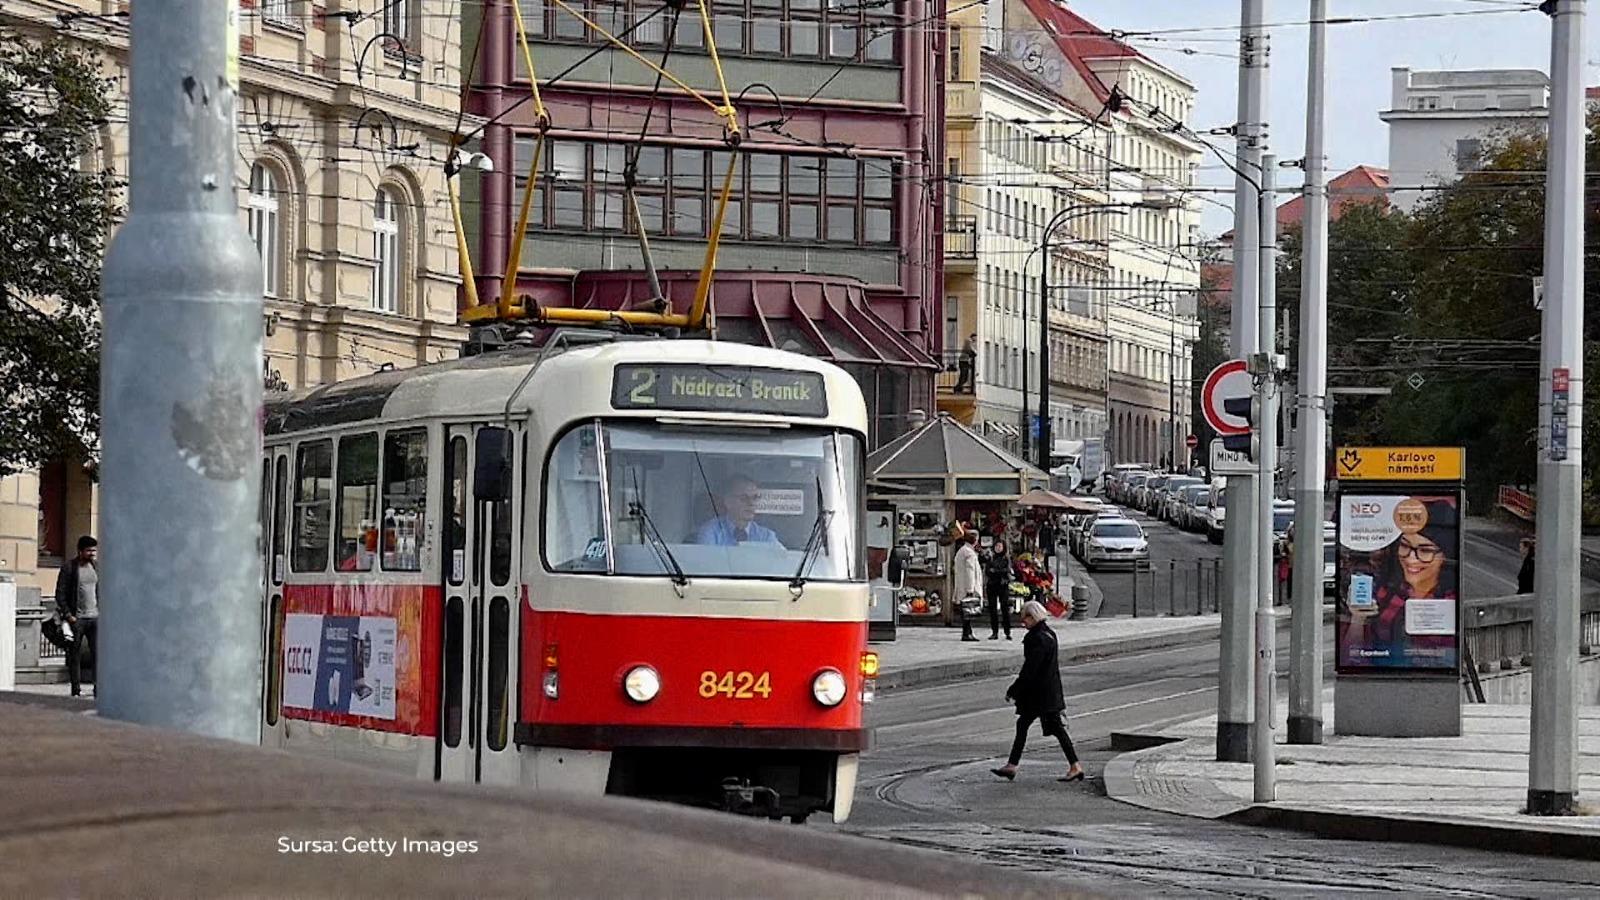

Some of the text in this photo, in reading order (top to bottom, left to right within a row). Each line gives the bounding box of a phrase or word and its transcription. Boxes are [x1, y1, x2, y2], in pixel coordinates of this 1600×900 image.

[630, 367, 656, 404] 2
[752, 379, 811, 400] Braník
[1388, 452, 1436, 462] Karlovo
[1351, 503, 1382, 514] NEO
[699, 671, 772, 698] 8424
